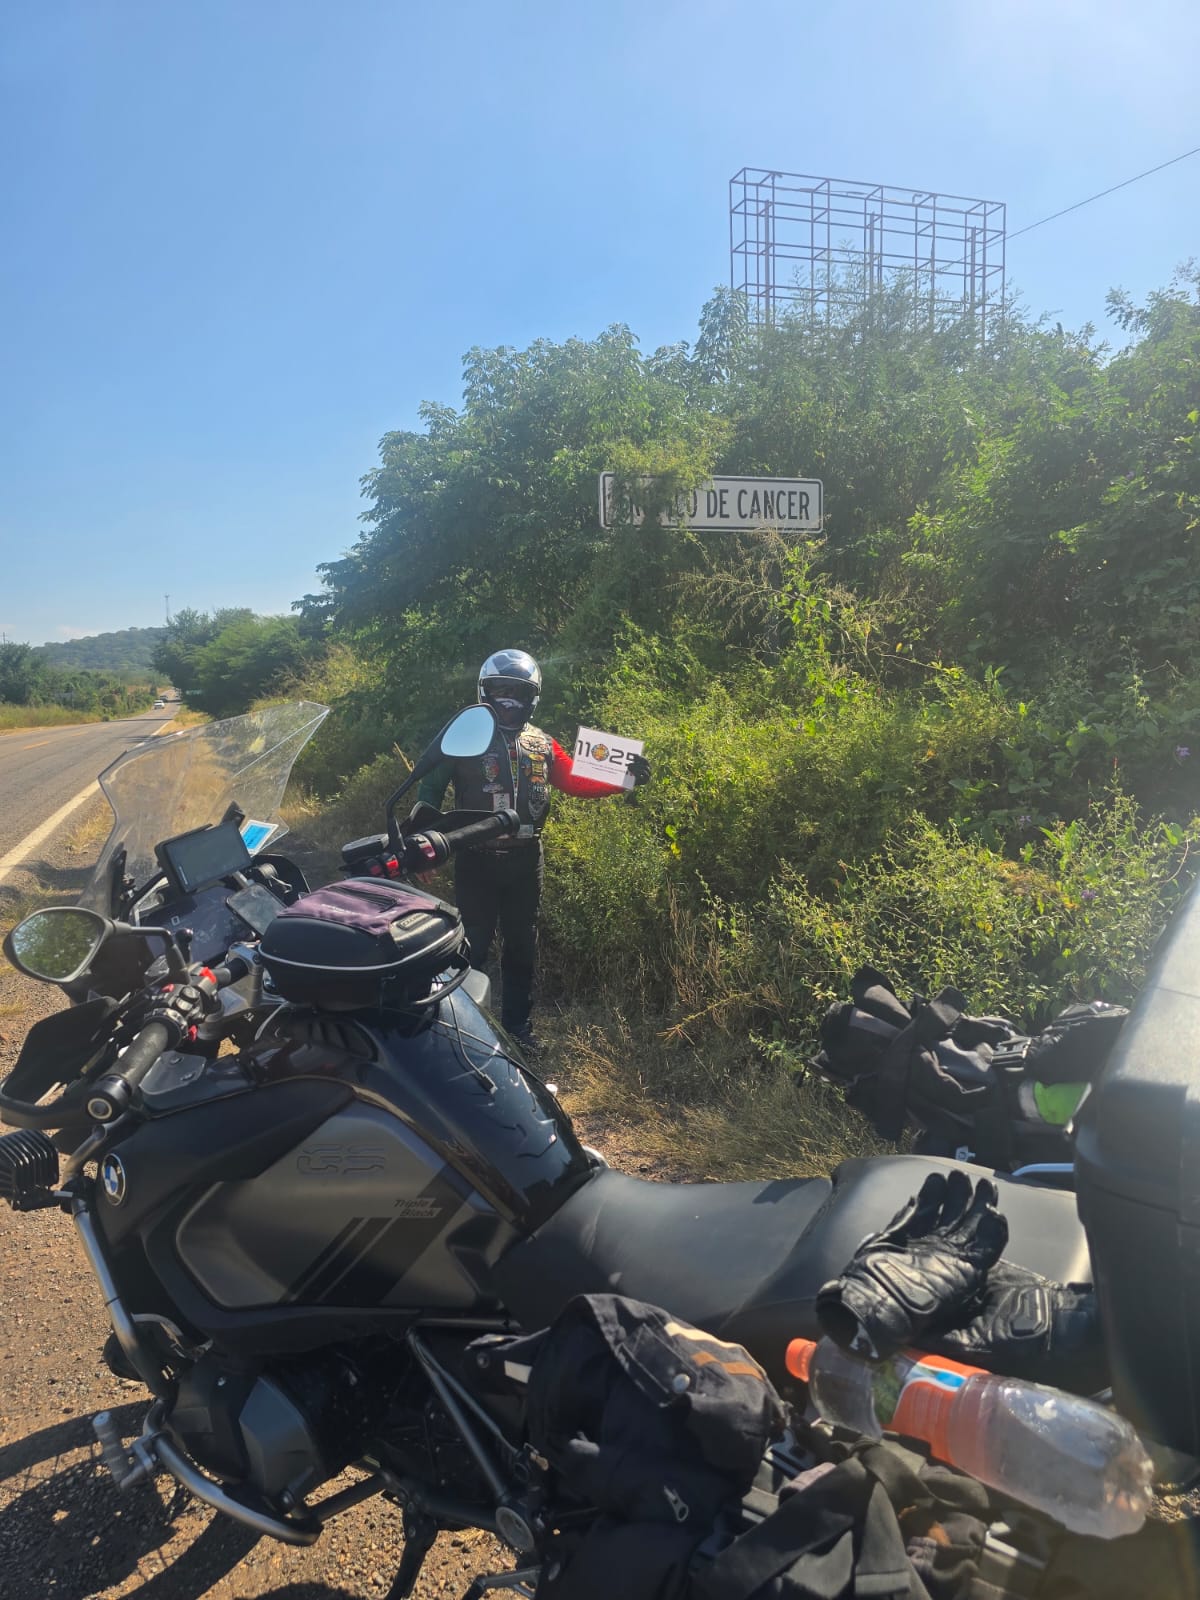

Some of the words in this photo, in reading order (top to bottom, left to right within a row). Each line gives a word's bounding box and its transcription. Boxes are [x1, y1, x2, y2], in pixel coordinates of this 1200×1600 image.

[706, 488, 730, 519] DE
[737, 488, 810, 520] CANCER
[297, 1143, 386, 1176] GS
[394, 1199, 430, 1209] Triple
[400, 1207, 435, 1217] Black
